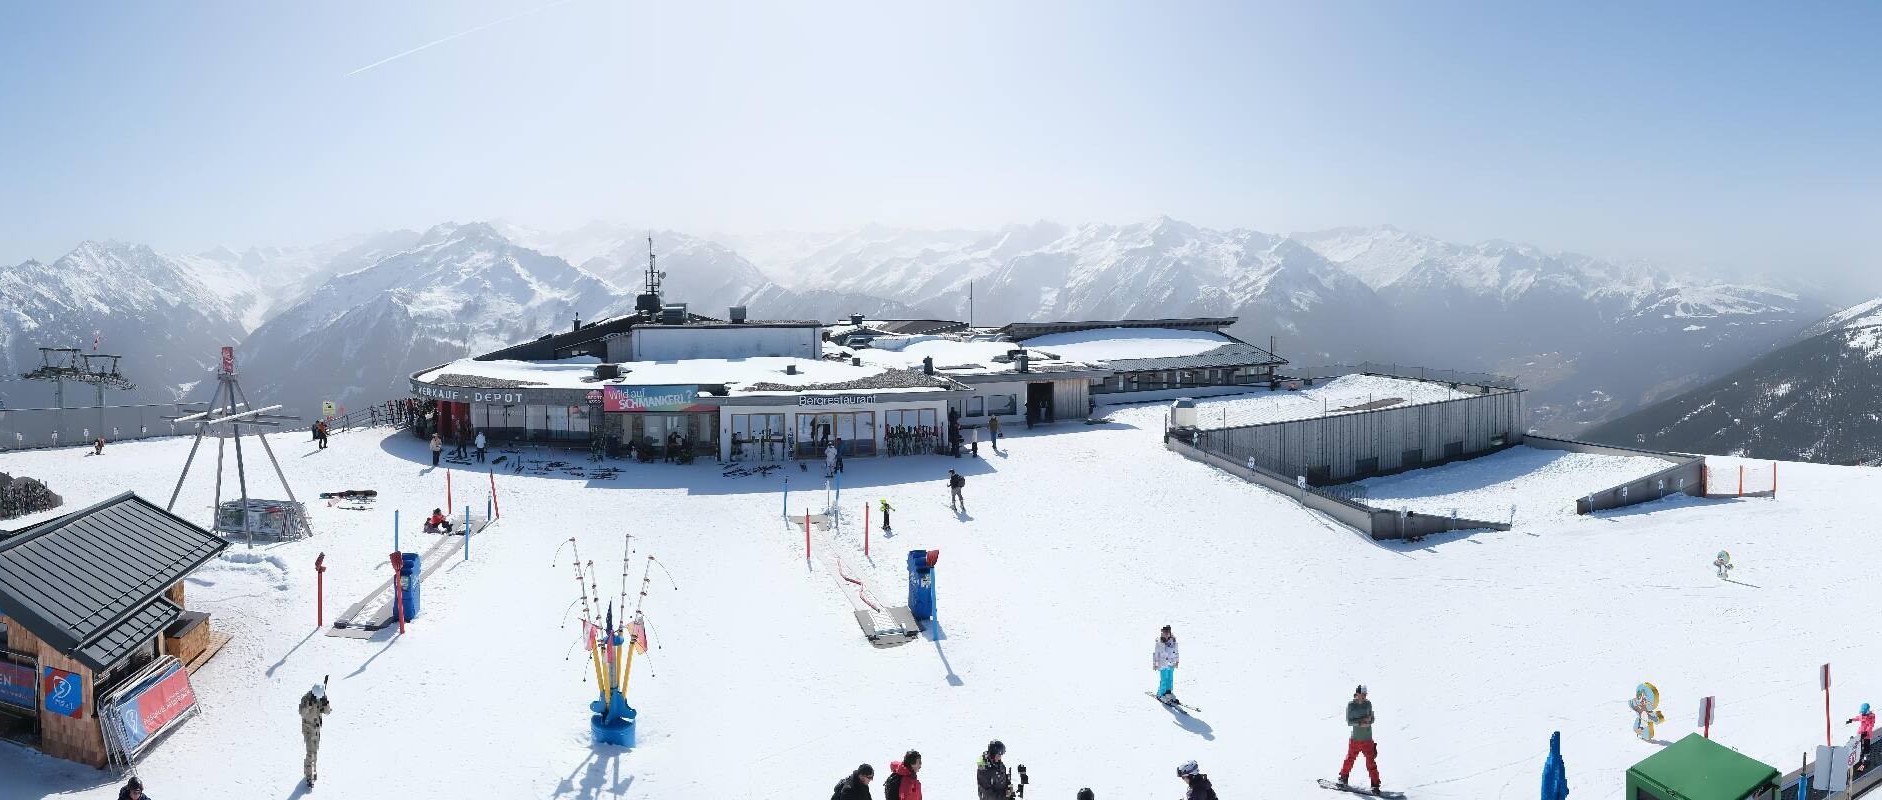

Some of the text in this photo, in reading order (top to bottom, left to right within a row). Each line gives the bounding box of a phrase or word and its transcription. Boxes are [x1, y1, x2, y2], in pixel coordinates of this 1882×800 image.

[418, 386, 459, 400] VERKAUF
[475, 392, 523, 403] DEPOT
[608, 388, 629, 400] Wild
[799, 395, 877, 406] Bergrestaurant
